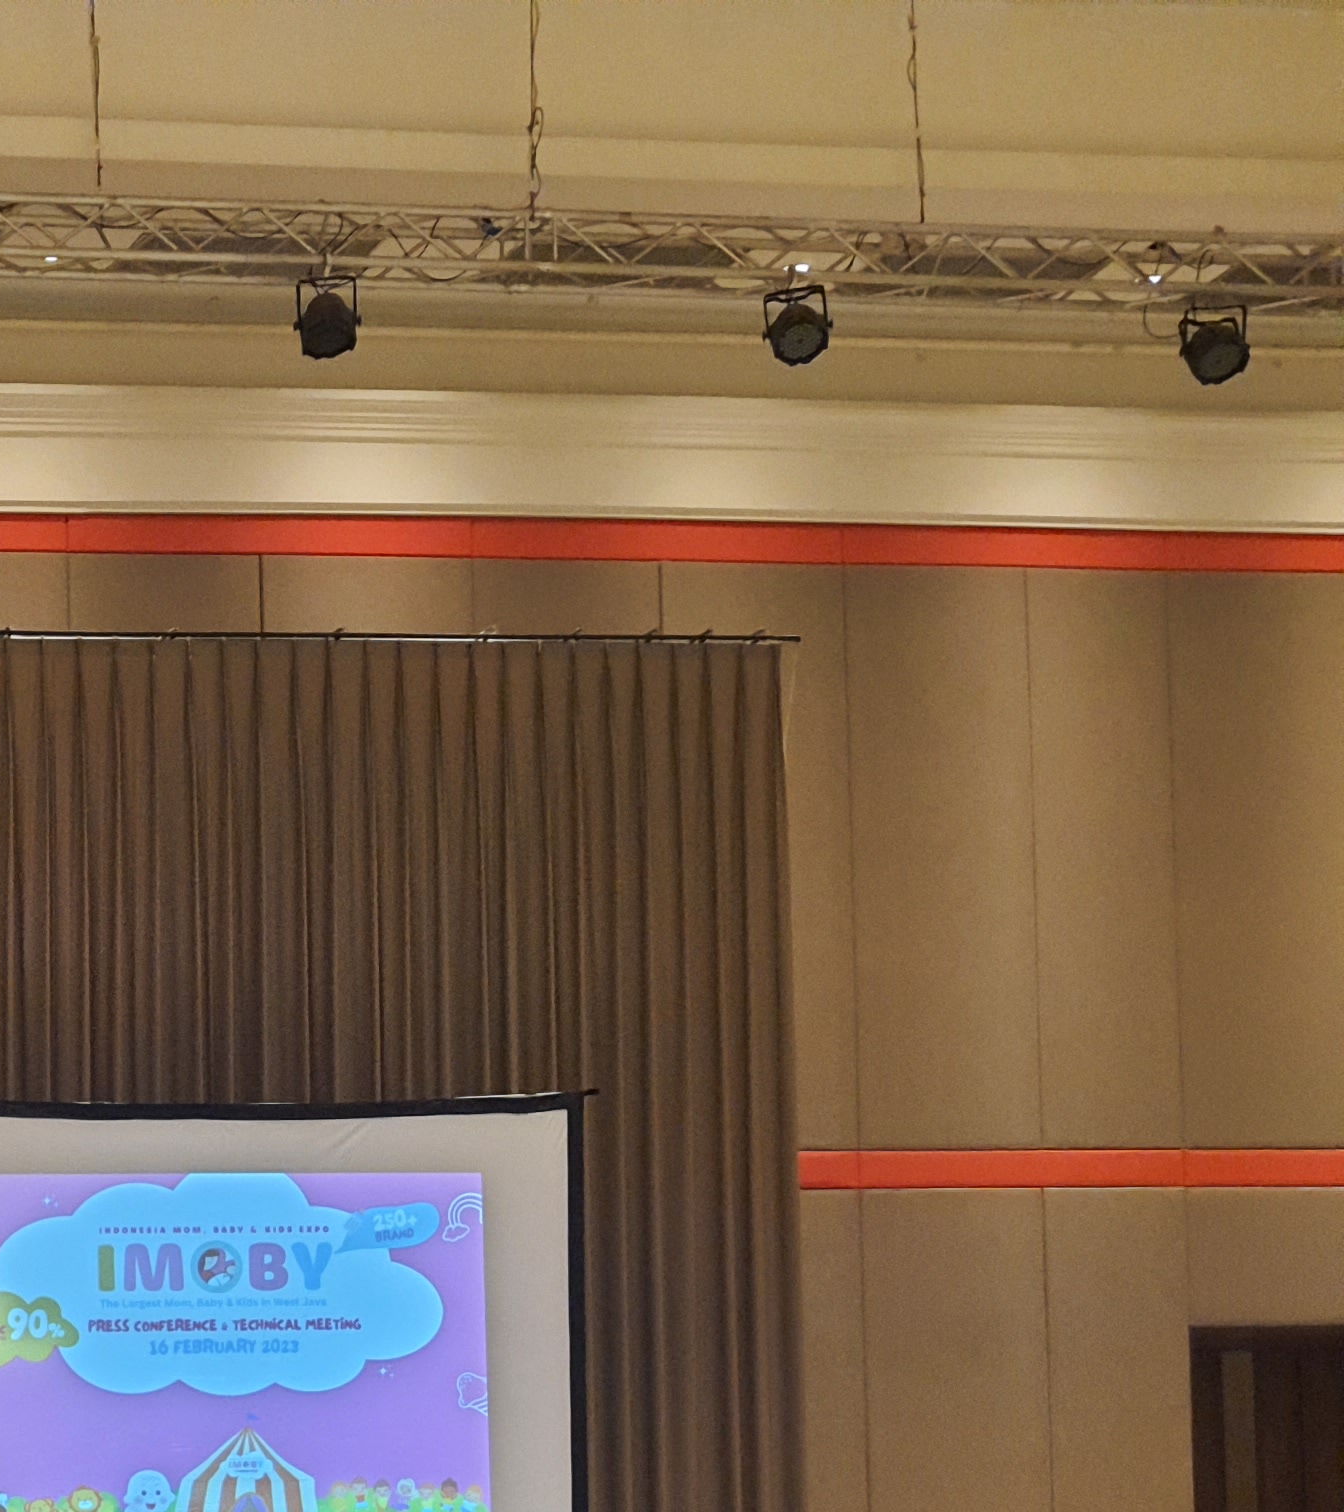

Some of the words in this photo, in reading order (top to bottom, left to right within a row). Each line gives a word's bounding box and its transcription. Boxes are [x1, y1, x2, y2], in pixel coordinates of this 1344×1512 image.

[373, 1209, 417, 1231] 250+
[98, 1240, 333, 1294] IMOBY
[7, 1307, 65, 1341] 90%
[88, 1319, 130, 1333] PRESS
[134, 1318, 218, 1332] CONFERENCE
[149, 1339, 169, 1355] 16
[173, 1338, 256, 1354] FEBRUARY
[262, 1339, 300, 1354] 2023
